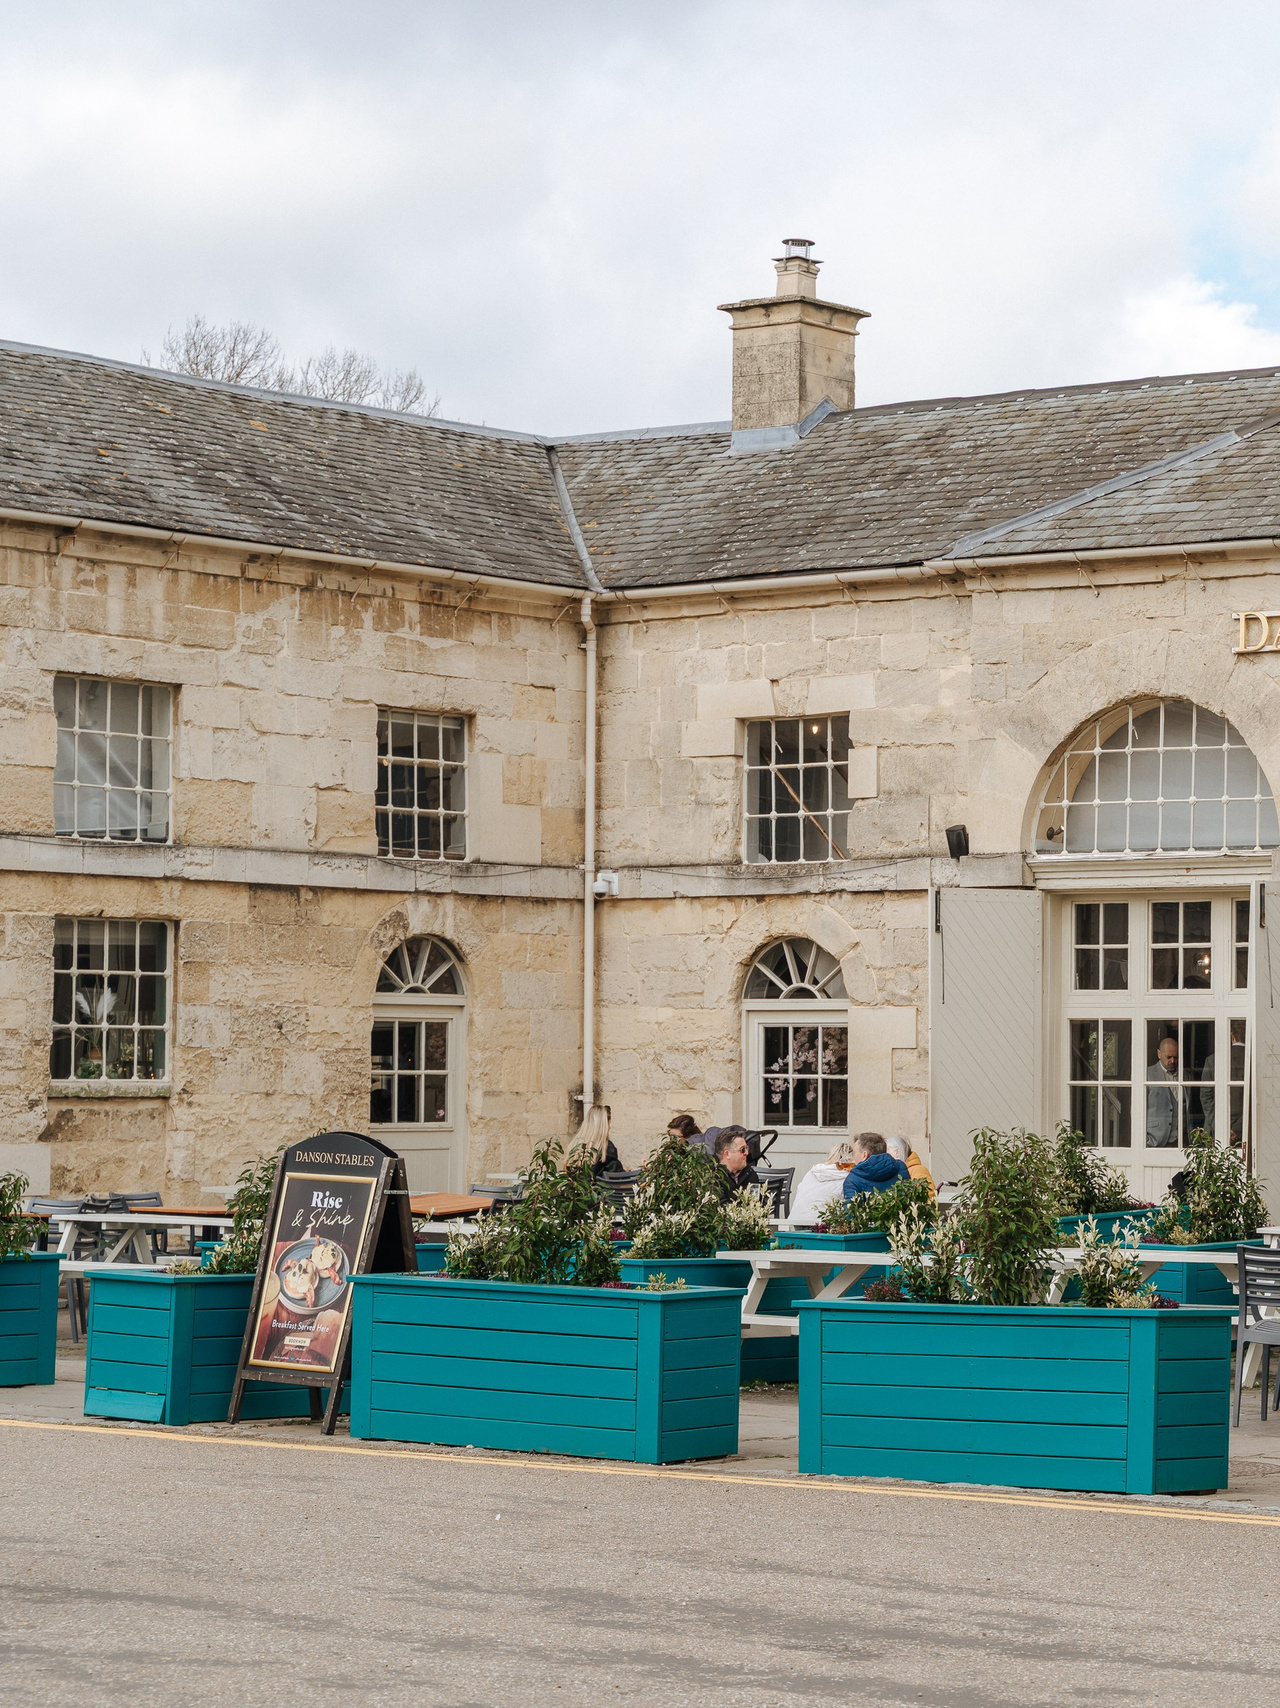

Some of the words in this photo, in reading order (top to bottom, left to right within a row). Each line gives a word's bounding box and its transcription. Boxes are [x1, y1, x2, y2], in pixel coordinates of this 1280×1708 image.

[295, 1150, 334, 1164] DANSON
[334, 1153, 375, 1167] STABLES
[310, 1190, 343, 1209] Rise
[291, 1208, 304, 1227] &
[305, 1207, 354, 1228] Shine
[271, 1319, 297, 1330] Breakfast
[297, 1321, 315, 1332] Served
[316, 1325, 330, 1333] Here
